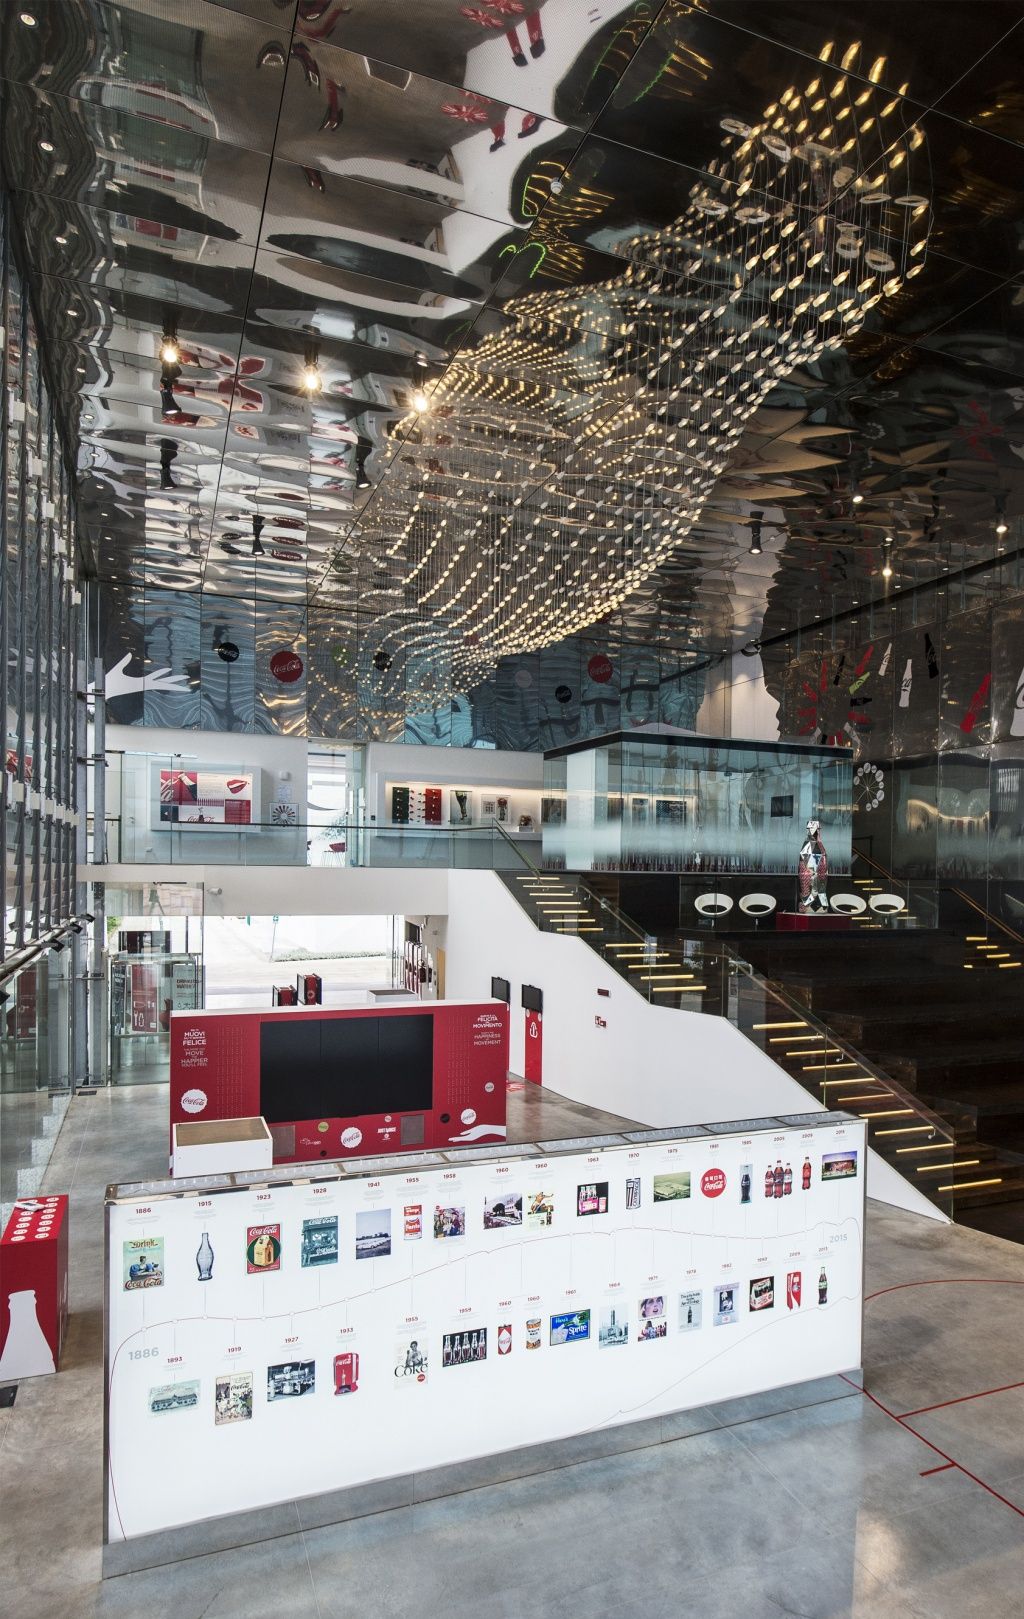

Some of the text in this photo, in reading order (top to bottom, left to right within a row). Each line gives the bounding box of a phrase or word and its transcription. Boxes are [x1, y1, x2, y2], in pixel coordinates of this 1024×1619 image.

[182, 1096, 205, 1106] Coca-Cola
[342, 1132, 361, 1144] Coca-Cola
[249, 1225, 278, 1237] Coca-Cola
[829, 1234, 848, 1243] 2015
[124, 1277, 163, 1291] Coca-Cola
[568, 1324, 588, 1336] Sprite
[127, 1347, 160, 1360] 1886
